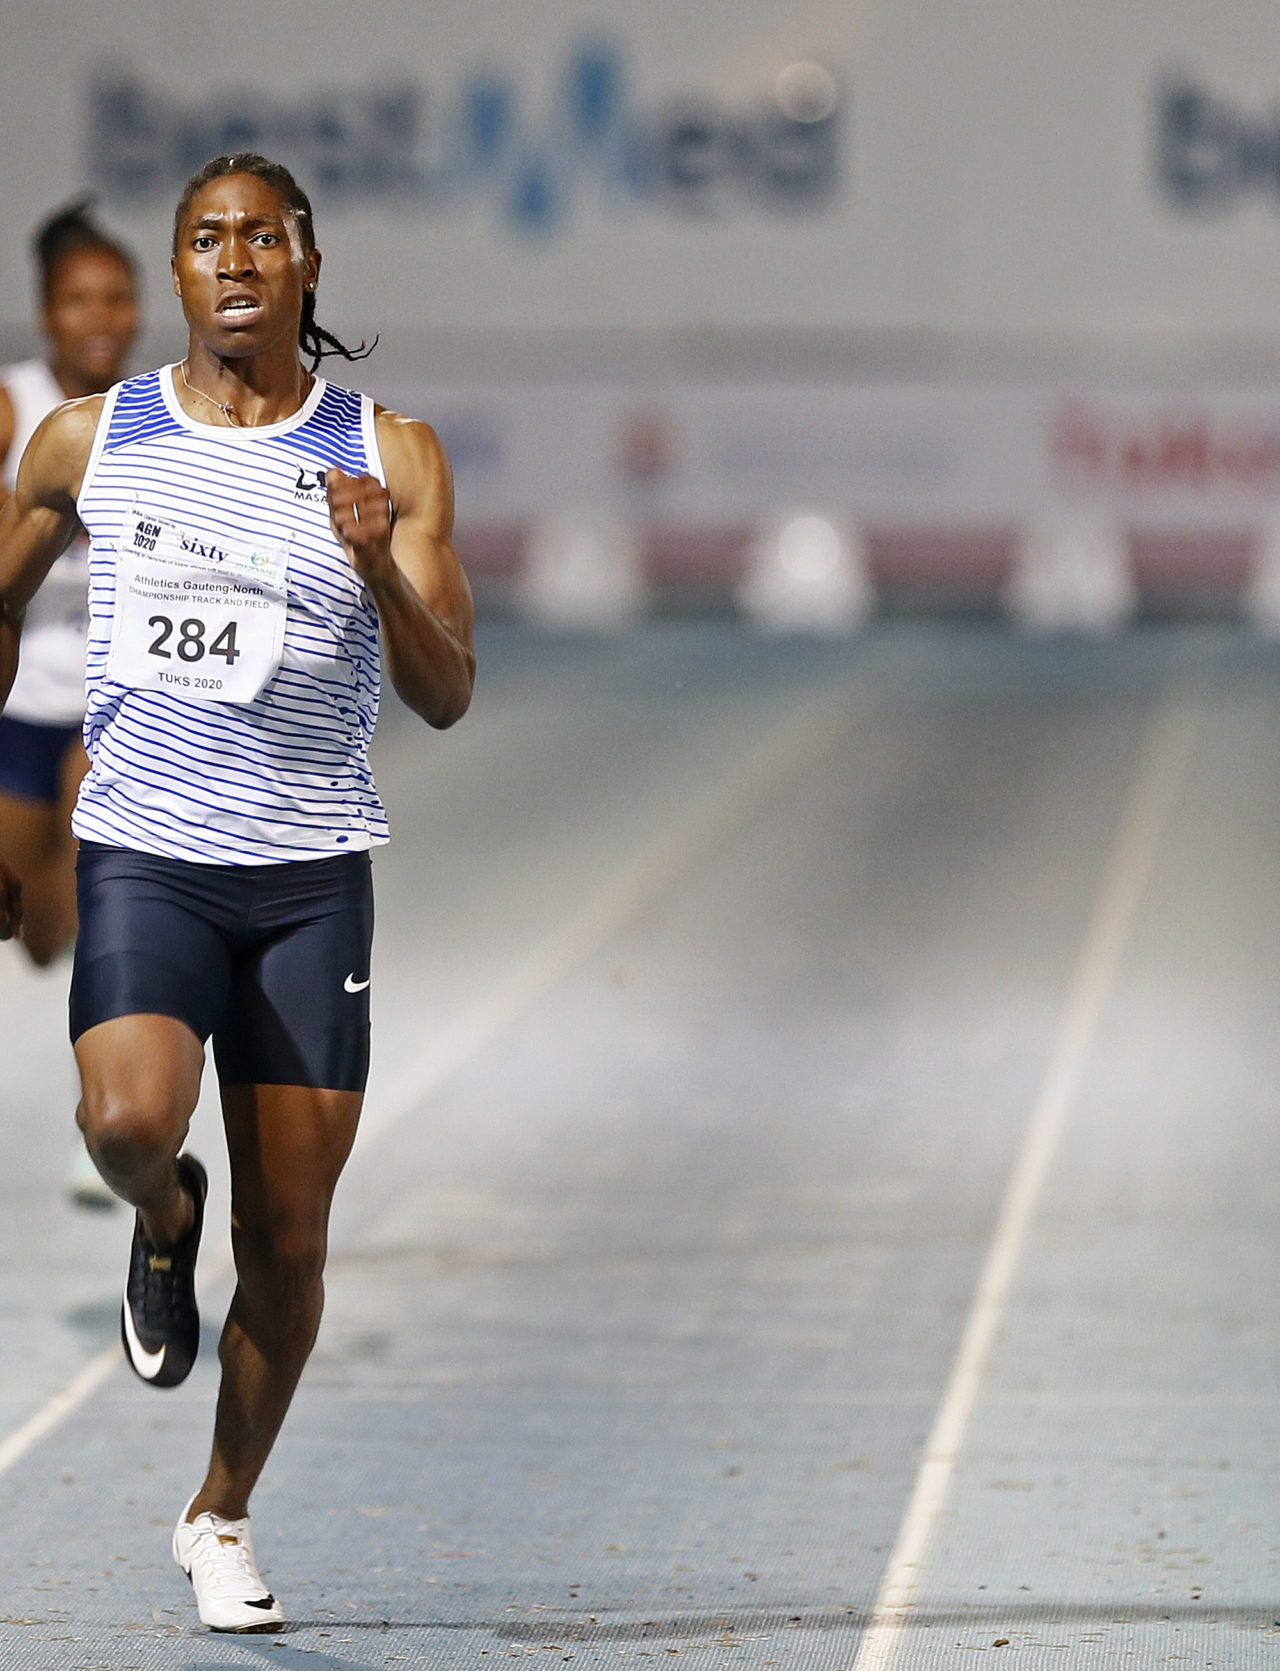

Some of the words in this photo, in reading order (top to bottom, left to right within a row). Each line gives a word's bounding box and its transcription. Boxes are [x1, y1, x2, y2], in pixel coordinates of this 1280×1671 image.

[136, 521, 162, 538] AGN
[133, 532, 157, 551] 1020
[134, 574, 180, 589] Athletics
[183, 580, 264, 596] Gauteng-North
[129, 585, 190, 602] CHAMPIONSHIP
[192, 595, 222, 606] TRACK
[223, 598, 242, 607] AND
[244, 600, 270, 609] FIELD
[148, 615, 240, 665] 284
[158, 672, 190, 687] TUKS
[194, 677, 223, 690] 2020
